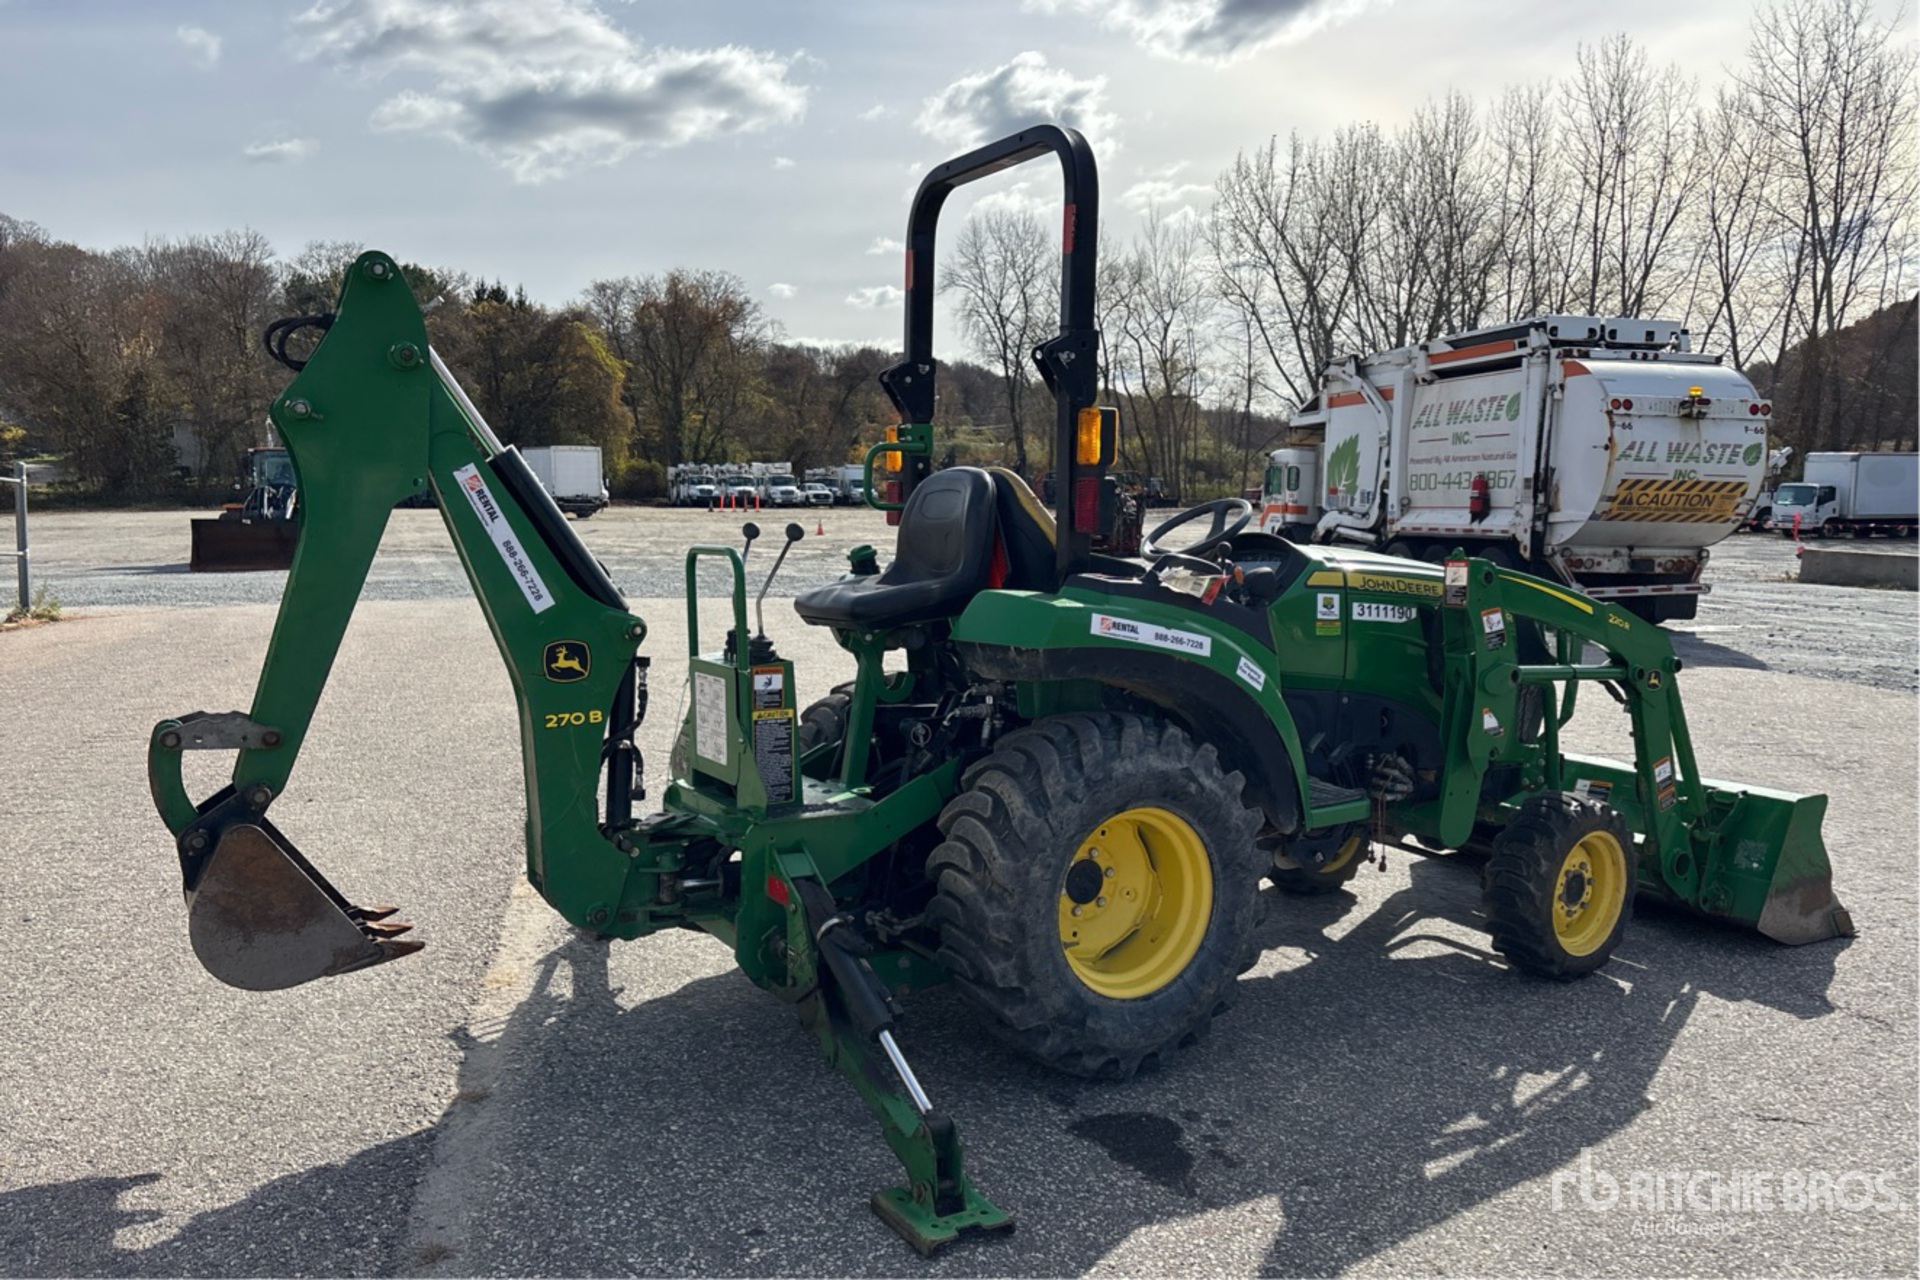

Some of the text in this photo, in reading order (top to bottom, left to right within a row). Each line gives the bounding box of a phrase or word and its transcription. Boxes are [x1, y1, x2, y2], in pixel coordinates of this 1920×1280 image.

[1412, 394, 1508, 429] ALL WASTE
[1451, 430, 1473, 446] INC.
[1616, 440, 1742, 464] ALL WASTE
[1409, 469, 1517, 491] 800-443867
[1672, 468, 1699, 481] INC.
[475, 488, 499, 524] RENTAL
[1635, 492, 1716, 508] CAUTION
[502, 539, 544, 602] 888-266-7228
[1359, 576, 1396, 592] JOHN
[1397, 579, 1439, 596] DEERE
[1357, 603, 1413, 620] 3111190
[1111, 622, 1140, 635] RENTAL
[1154, 632, 1204, 650] 888-266-7228
[545, 709, 602, 729] 270 B
